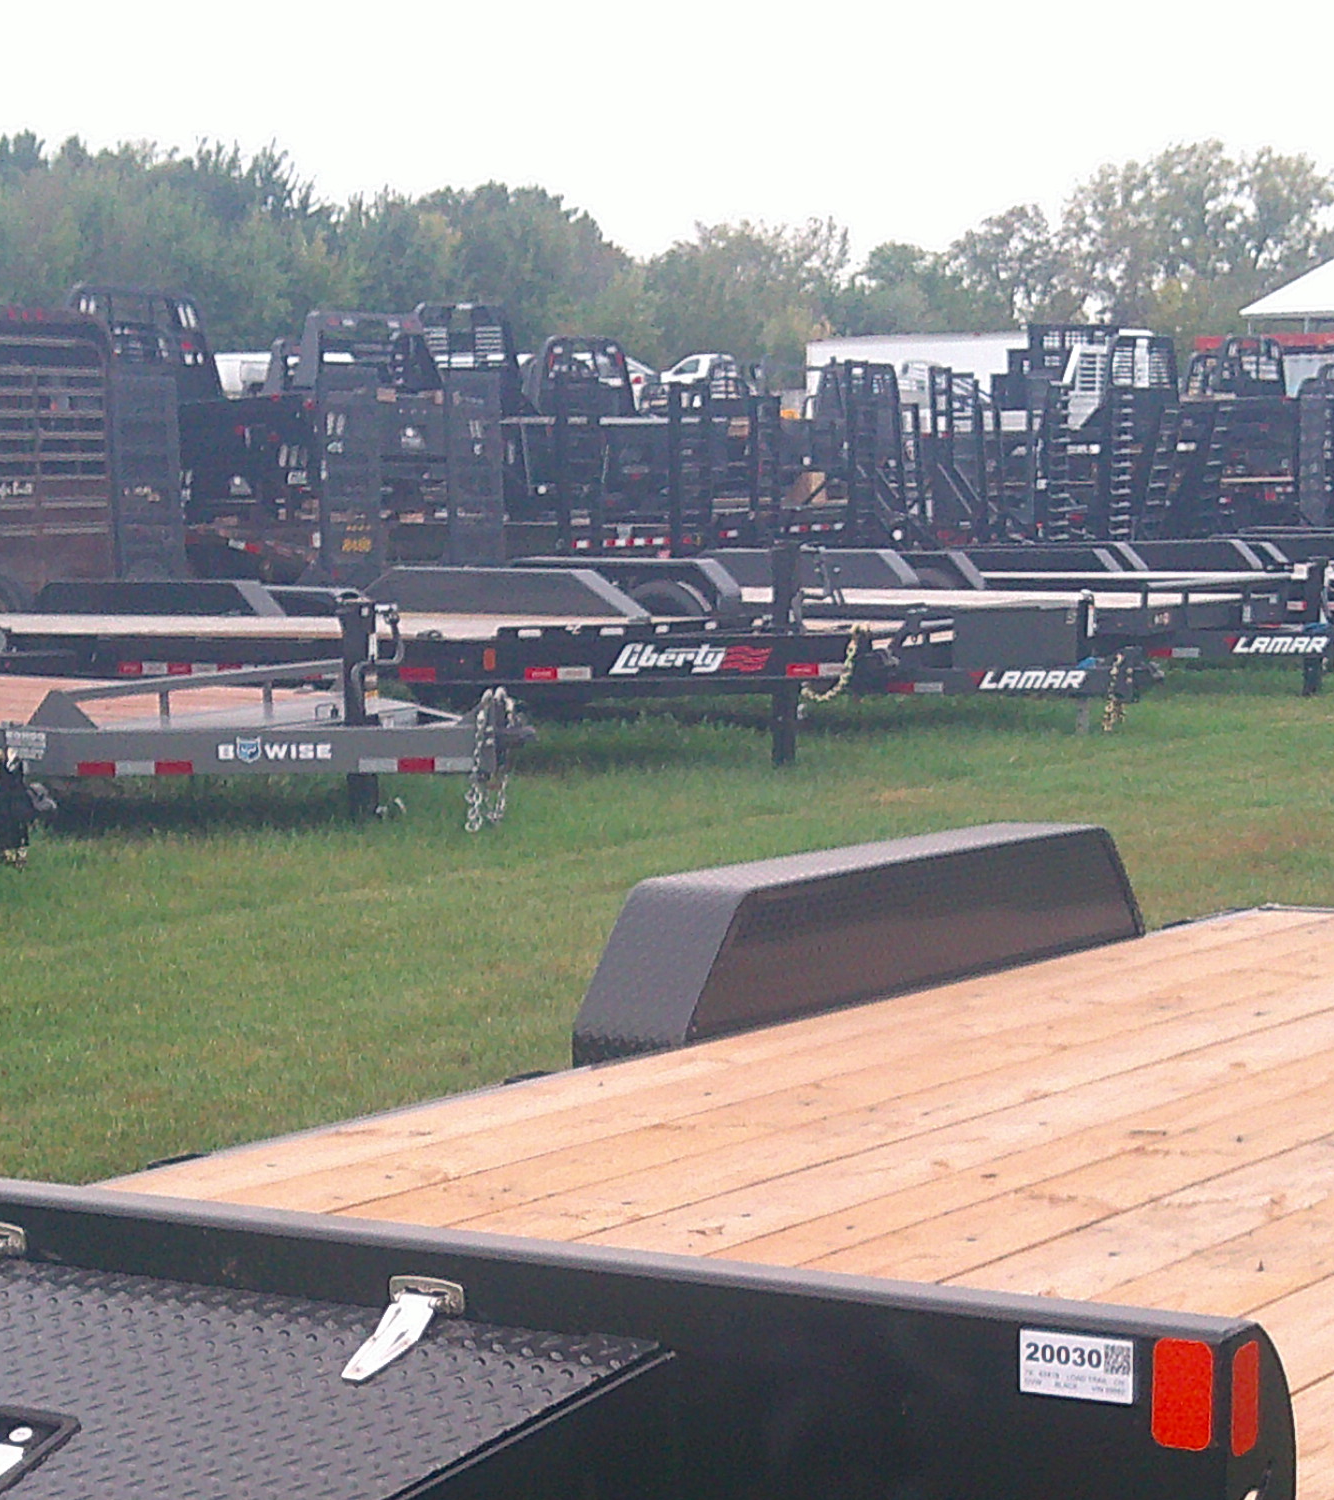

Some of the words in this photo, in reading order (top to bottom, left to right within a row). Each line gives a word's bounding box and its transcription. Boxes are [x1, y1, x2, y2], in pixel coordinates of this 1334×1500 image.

[1232, 636, 1330, 654] LAMAR
[608, 642, 726, 675] Liberty
[978, 670, 1086, 690] LAMAR
[1025, 1342, 1102, 1368] 20030
